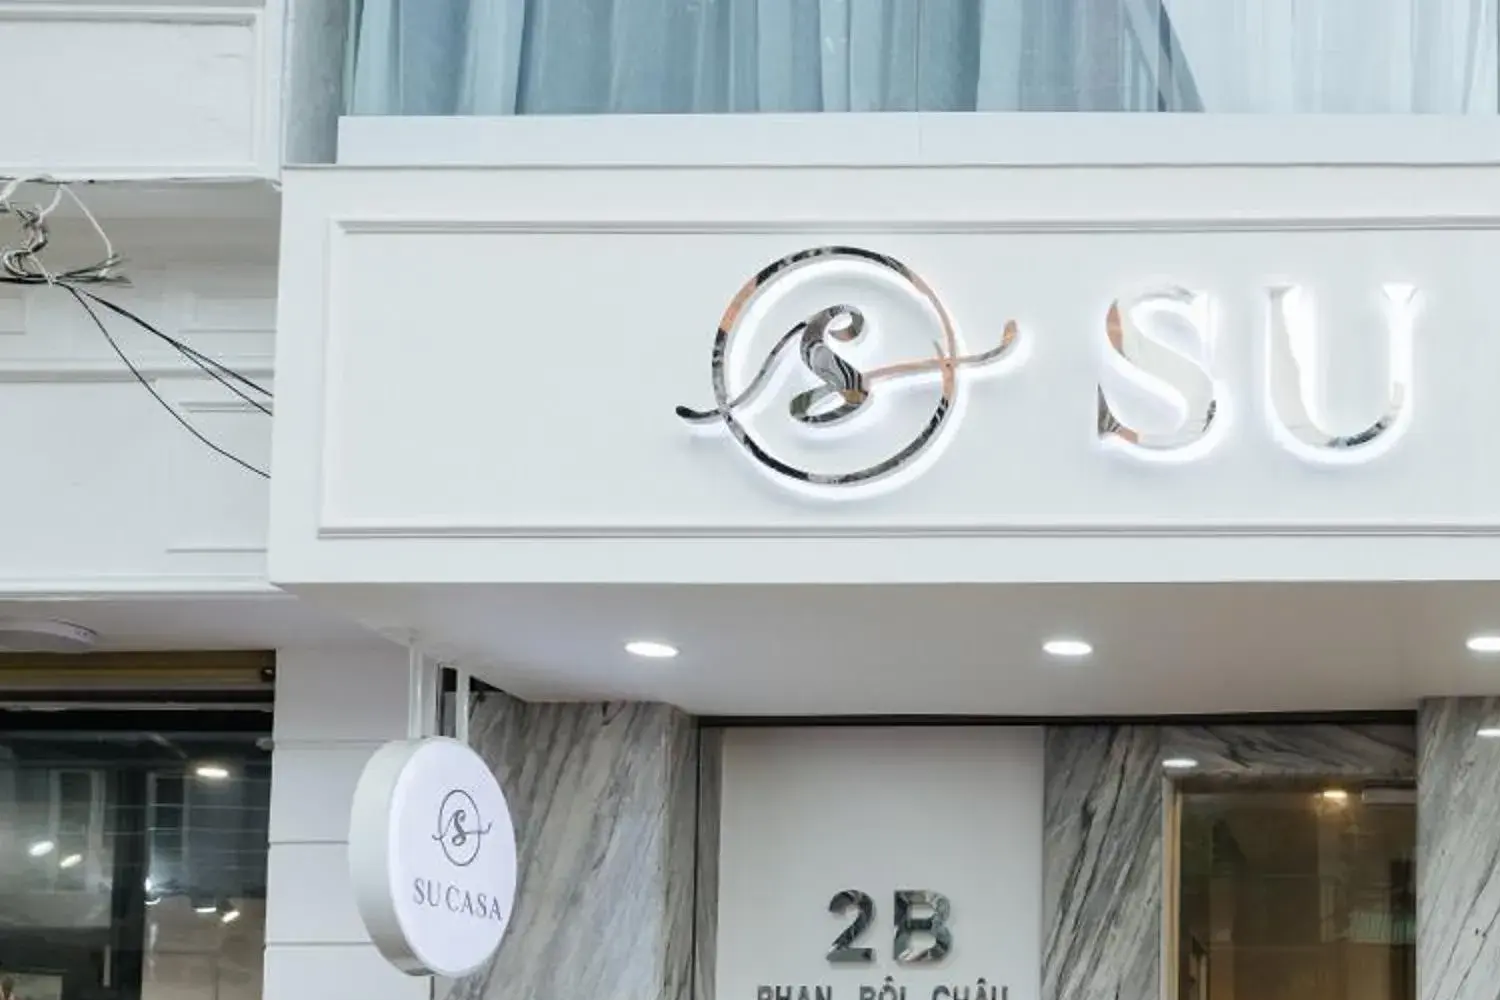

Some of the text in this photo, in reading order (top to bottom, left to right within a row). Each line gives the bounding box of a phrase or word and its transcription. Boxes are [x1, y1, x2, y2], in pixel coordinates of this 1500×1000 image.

[1097, 283, 1420, 454] SU
[412, 877, 504, 921] SU CASA
[825, 888, 954, 964] 2B
